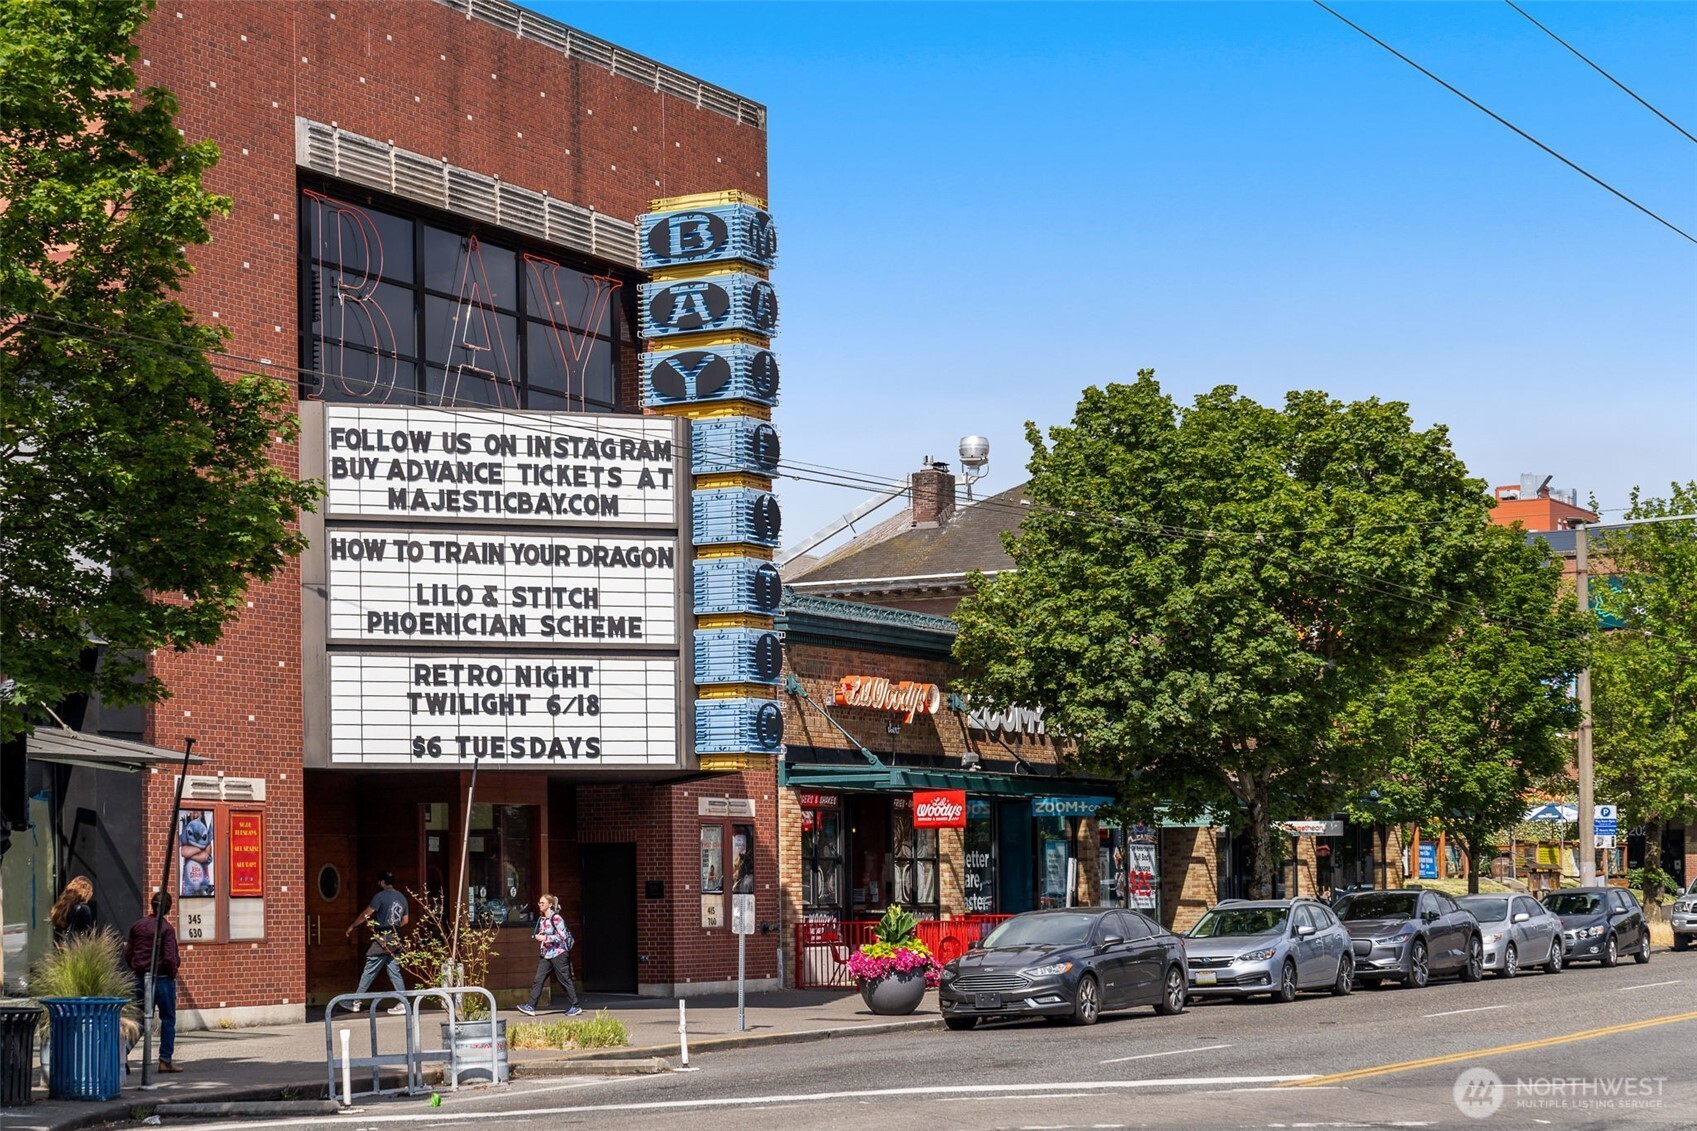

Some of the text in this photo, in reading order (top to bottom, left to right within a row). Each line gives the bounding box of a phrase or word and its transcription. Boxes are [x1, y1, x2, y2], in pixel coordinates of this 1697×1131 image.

[303, 188, 623, 410] BAY
[661, 212, 722, 401] BAY
[331, 428, 672, 462] FOLLOW US ON INSTAGRAM
[332, 457, 672, 489] BUY ADVANCE TICKETS AT
[388, 488, 619, 517] MAJESTICBAY.COM
[332, 538, 674, 568] HOW TO TRAIN YOUR DRAGON
[417, 584, 598, 609] LILO & STITCH
[368, 611, 642, 638] PHOENICIAN SCHEME
[415, 664, 593, 688] RETRO NIGHT
[407, 692, 599, 716] TWILIGHT 6/18
[413, 736, 600, 758] $6 TUESDAYS
[917, 804, 962, 822] Woody's
[966, 851, 989, 868] etter
[965, 870, 982, 891] are,
[188, 914, 201, 924] 345
[189, 928, 202, 938] 630
